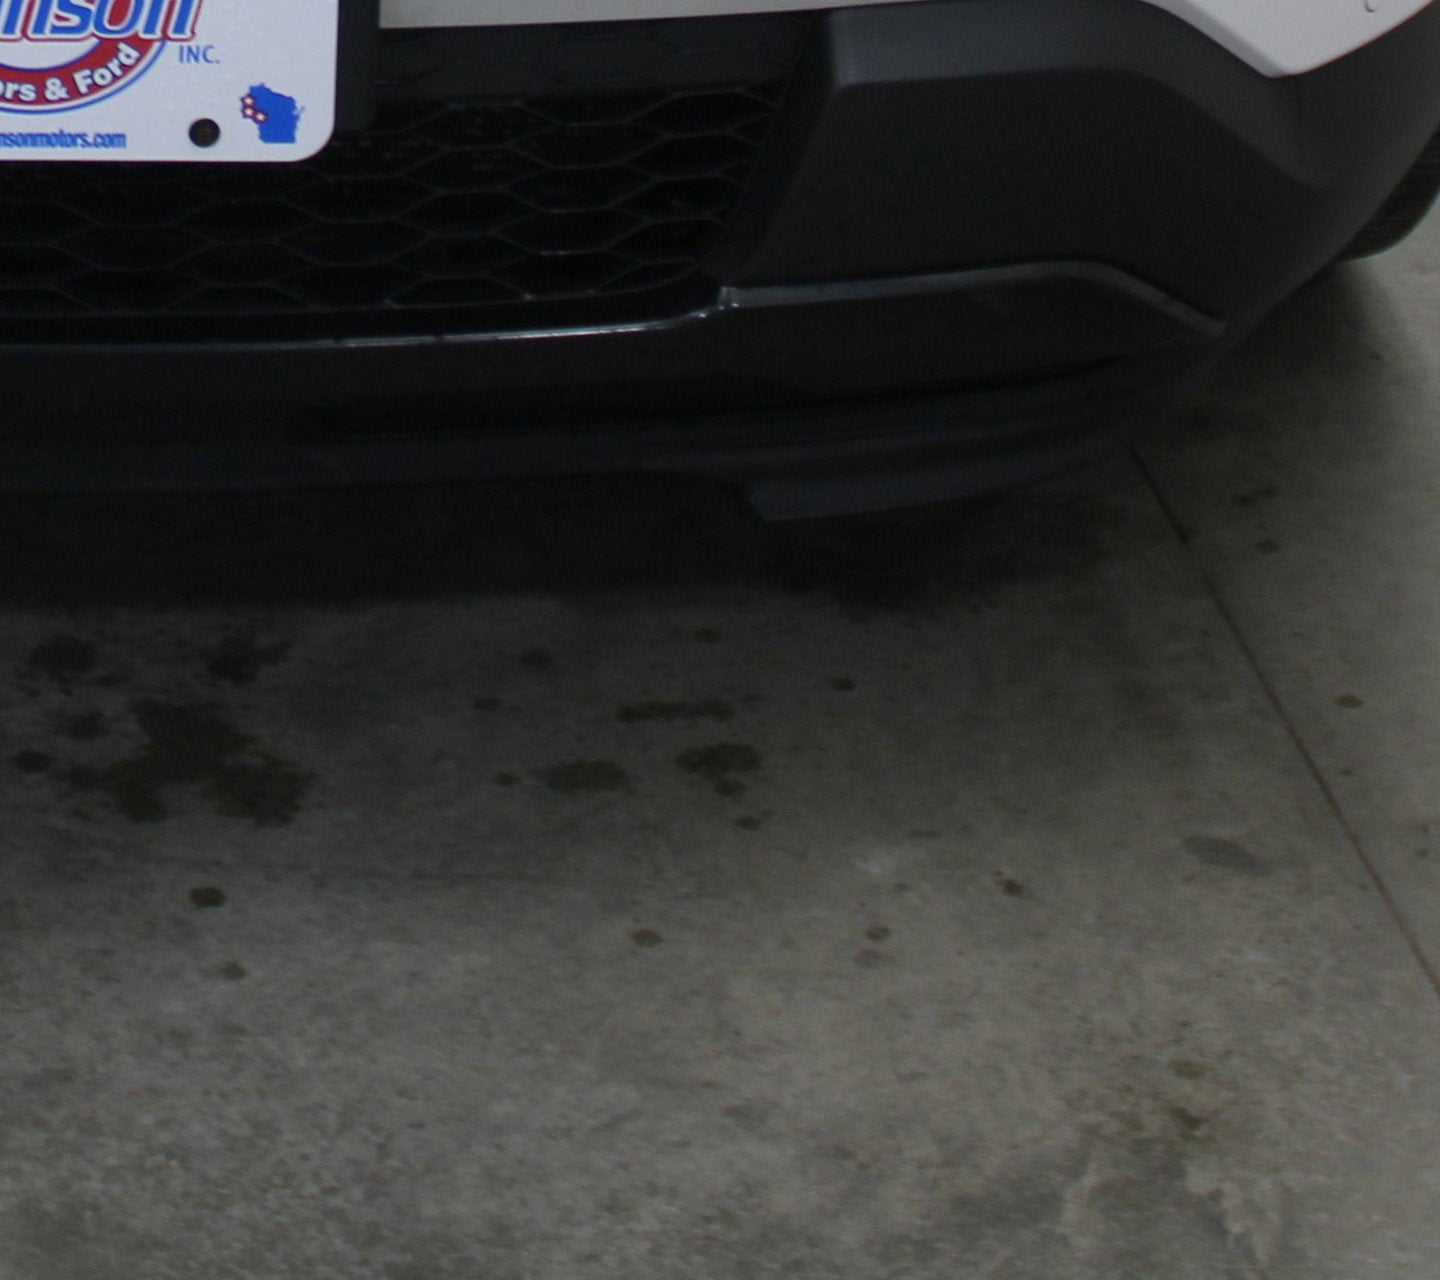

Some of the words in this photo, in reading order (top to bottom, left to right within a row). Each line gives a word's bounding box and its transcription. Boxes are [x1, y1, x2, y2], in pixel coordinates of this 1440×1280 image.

[44, 77, 69, 101] &
[72, 42, 141, 95] Ford
[178, 45, 220, 64] INC.
